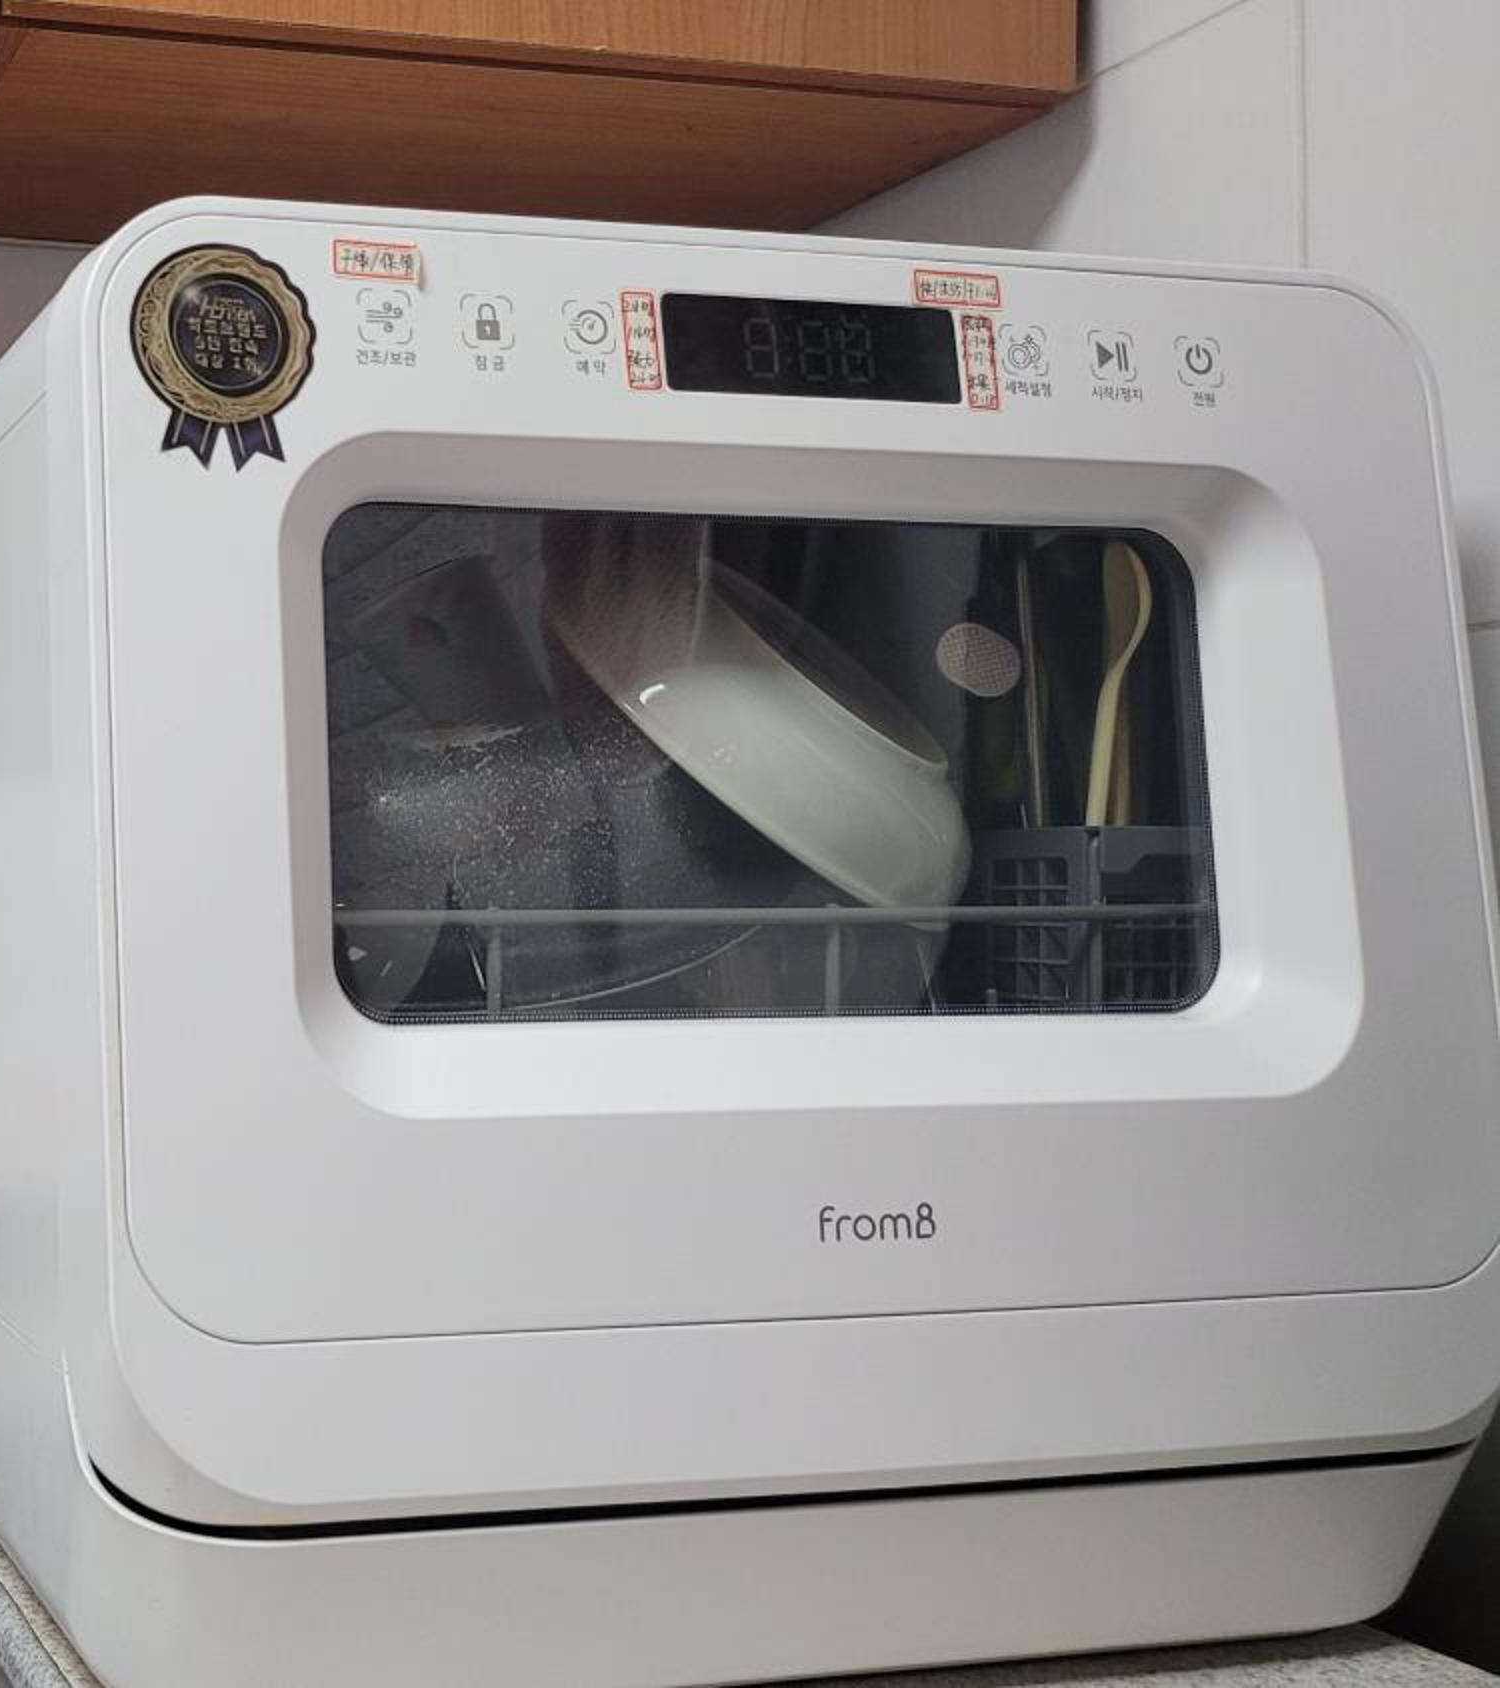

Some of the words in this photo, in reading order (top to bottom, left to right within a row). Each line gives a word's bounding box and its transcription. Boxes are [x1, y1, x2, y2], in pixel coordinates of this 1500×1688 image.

[355, 349, 417, 367] 건조/보관
[1092, 386, 1143, 403] 시작/정지
[1193, 391, 1216, 407] 전원
[819, 1202, 937, 1243] from8
